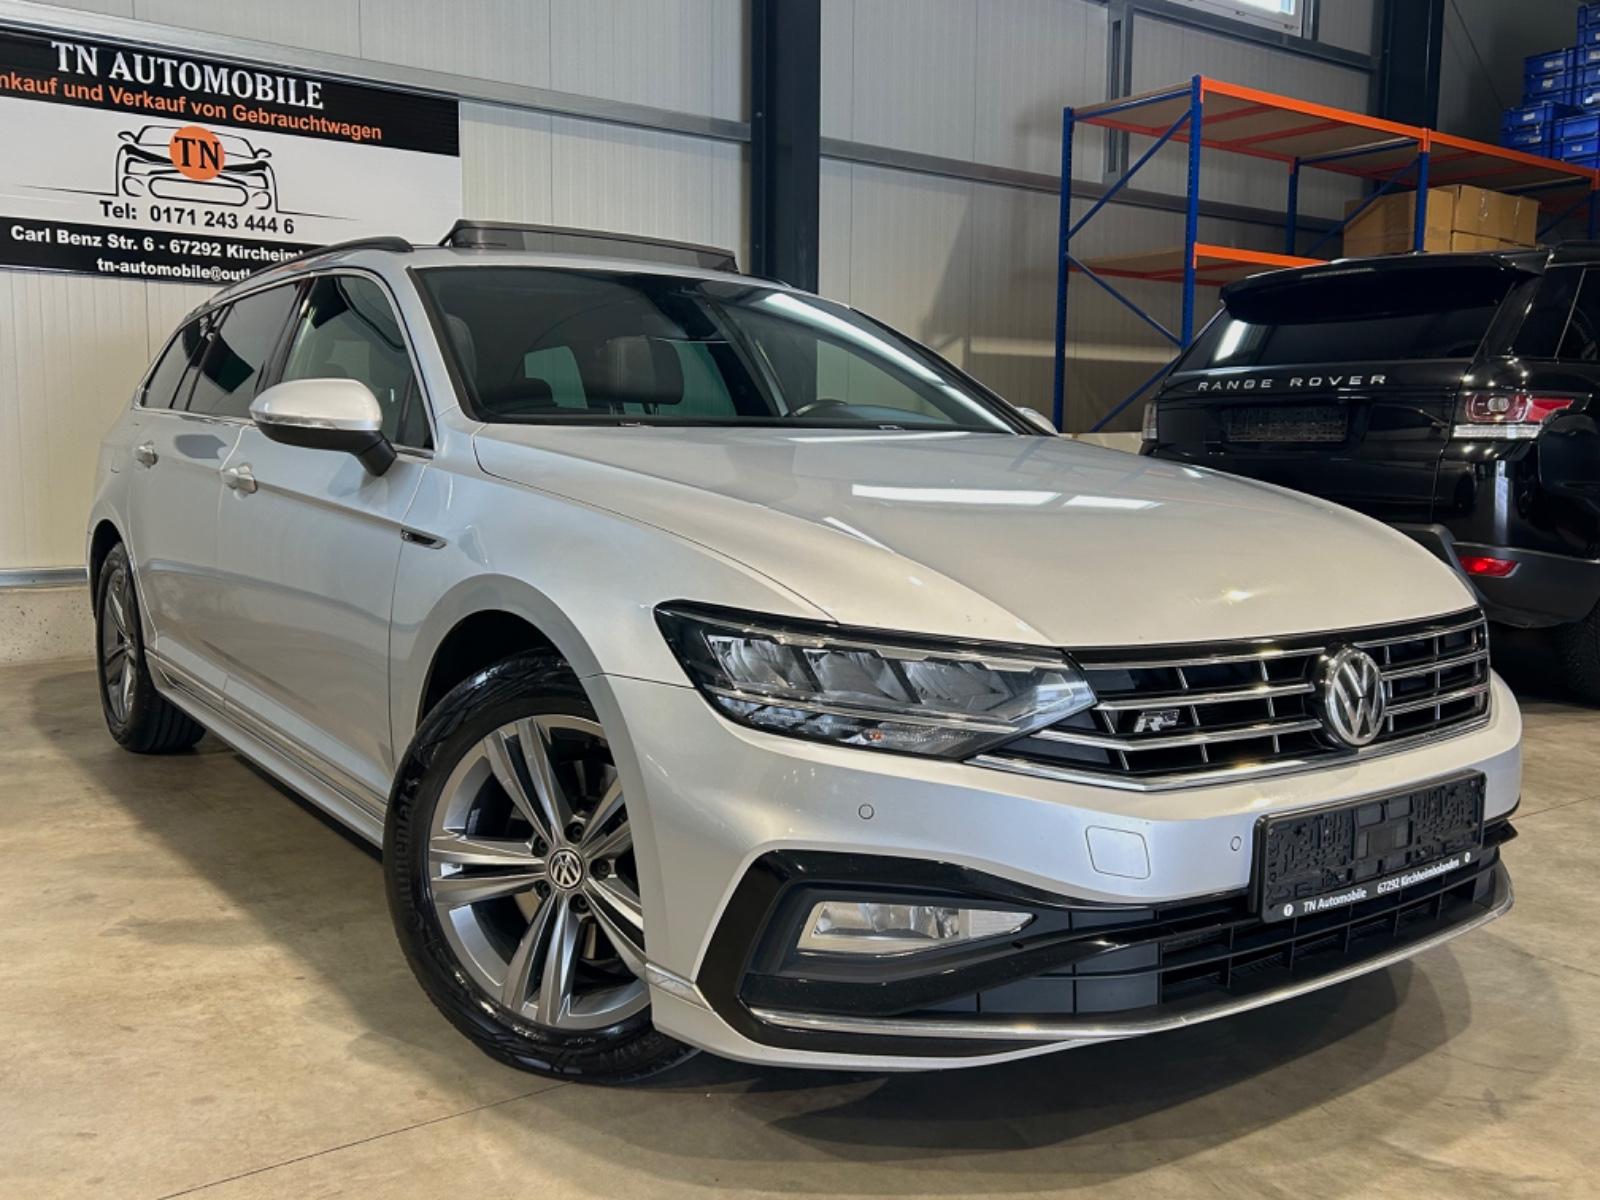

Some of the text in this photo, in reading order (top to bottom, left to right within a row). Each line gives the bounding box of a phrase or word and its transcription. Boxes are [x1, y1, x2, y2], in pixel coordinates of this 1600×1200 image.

[51, 40, 325, 110] TN AUTOMOBILE
[0, 71, 383, 141] nkauf und Verkauf von Gebrauchtwagen
[174, 137, 222, 172] TN
[100, 201, 295, 234] Tel: 0171 243 444 6
[10, 224, 51, 243] Carl
[57, 228, 102, 248] Benz
[106, 233, 139, 251] Str.
[143, 235, 155, 252] 6
[169, 239, 222, 257] 67292
[226, 243, 304, 265] Kircheim
[1198, 374, 1387, 391] RANGE ROVER
[1303, 901, 1317, 913] TN
[1317, 888, 1367, 909] Automobile
[1377, 880, 1400, 894] 67292
